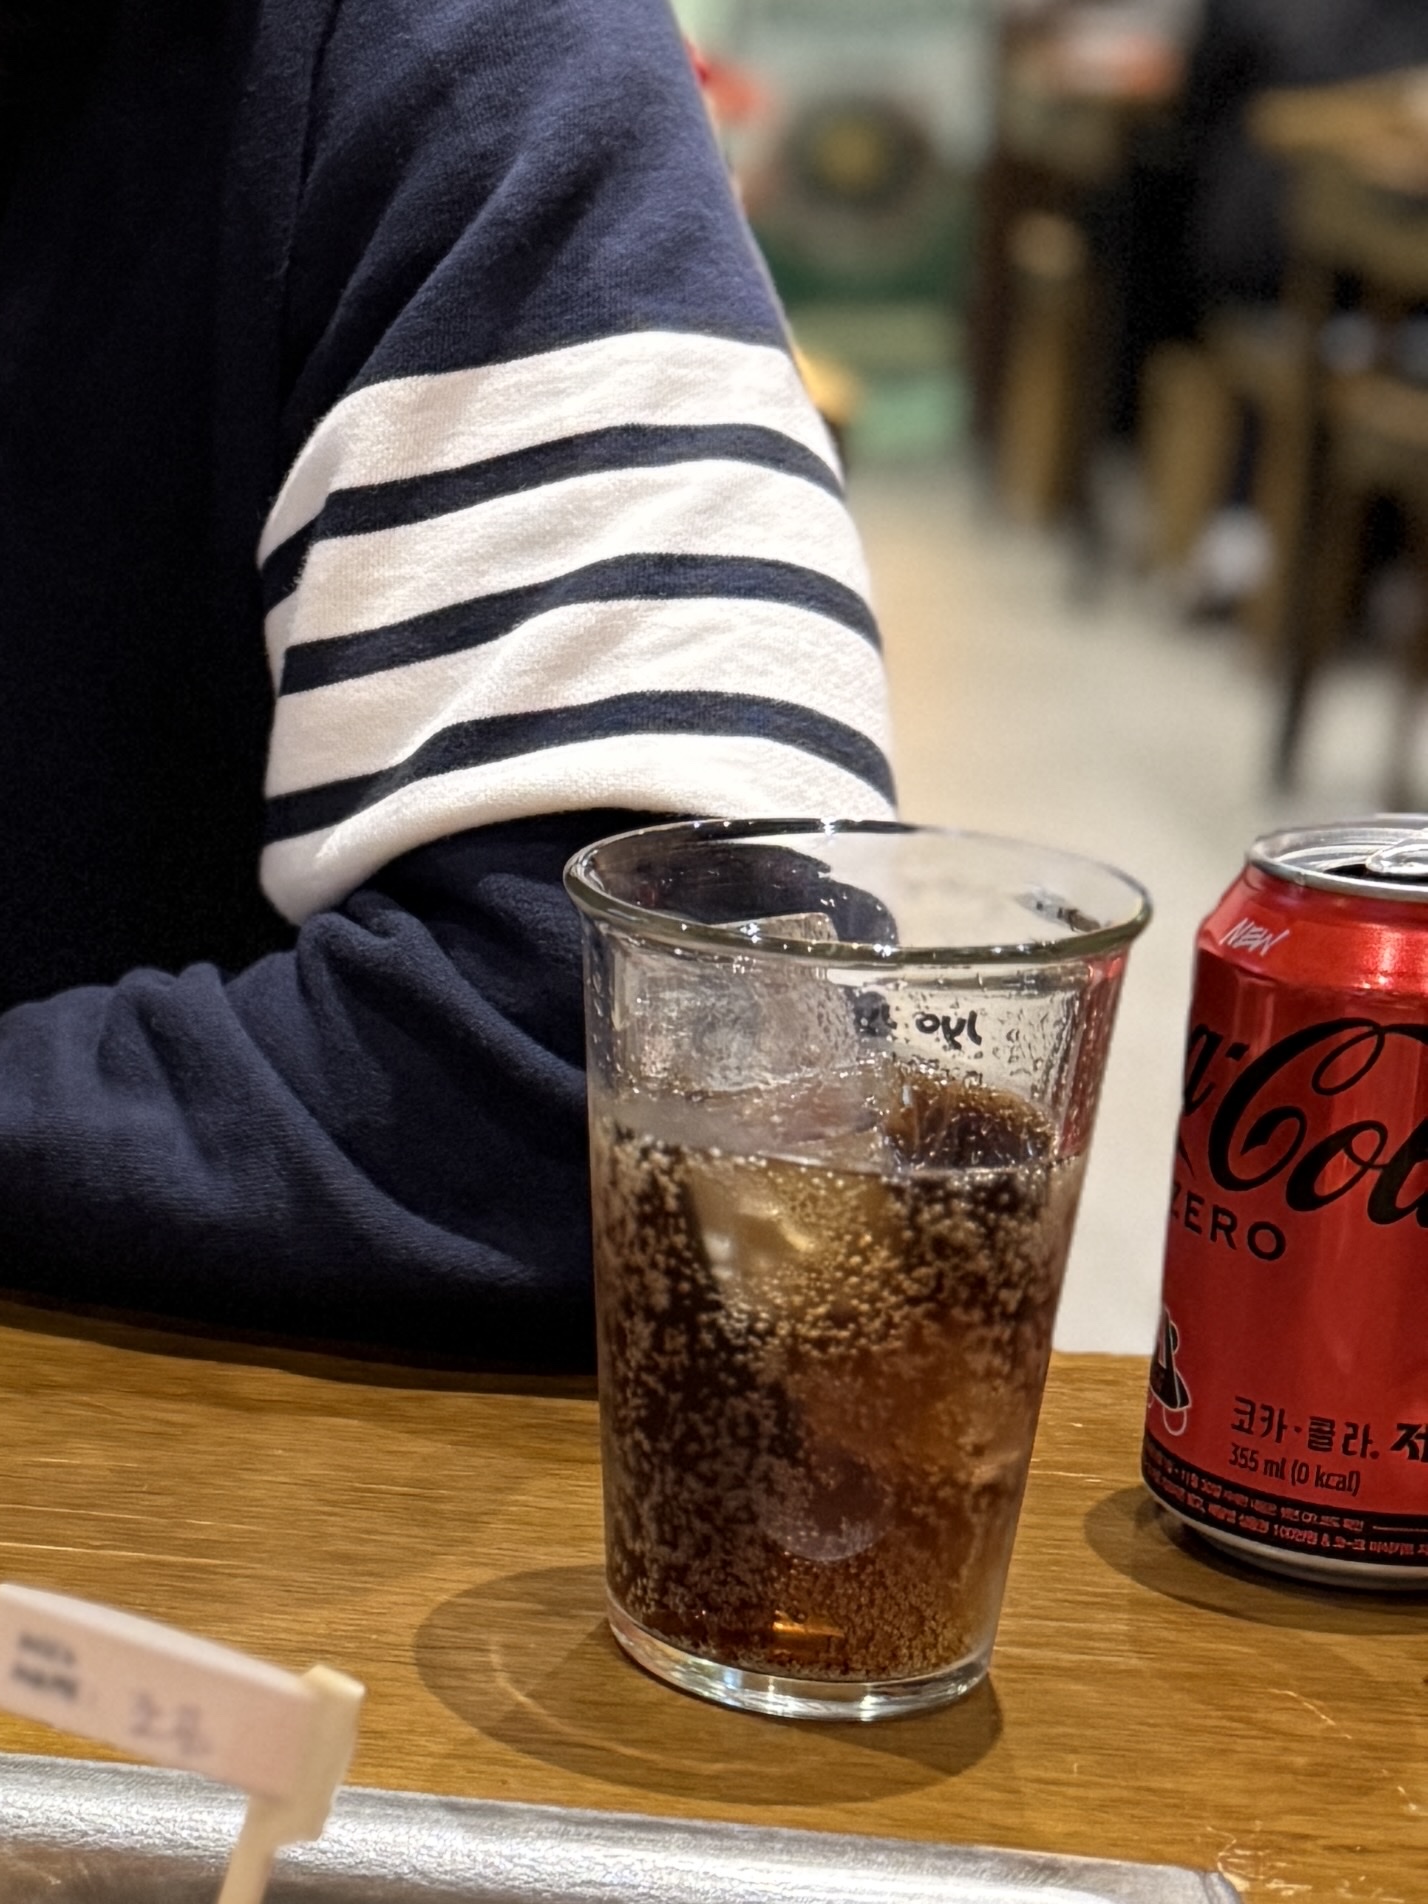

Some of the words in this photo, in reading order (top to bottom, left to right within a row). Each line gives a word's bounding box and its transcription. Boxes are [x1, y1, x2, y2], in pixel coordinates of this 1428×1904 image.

[1219, 917, 1290, 957] NEW
[1228, 1442, 1259, 1473] 355
[1263, 1458, 1286, 1481] ml
[1290, 1459, 1311, 1488] (0
[1315, 1464, 1362, 1498] kcal)
